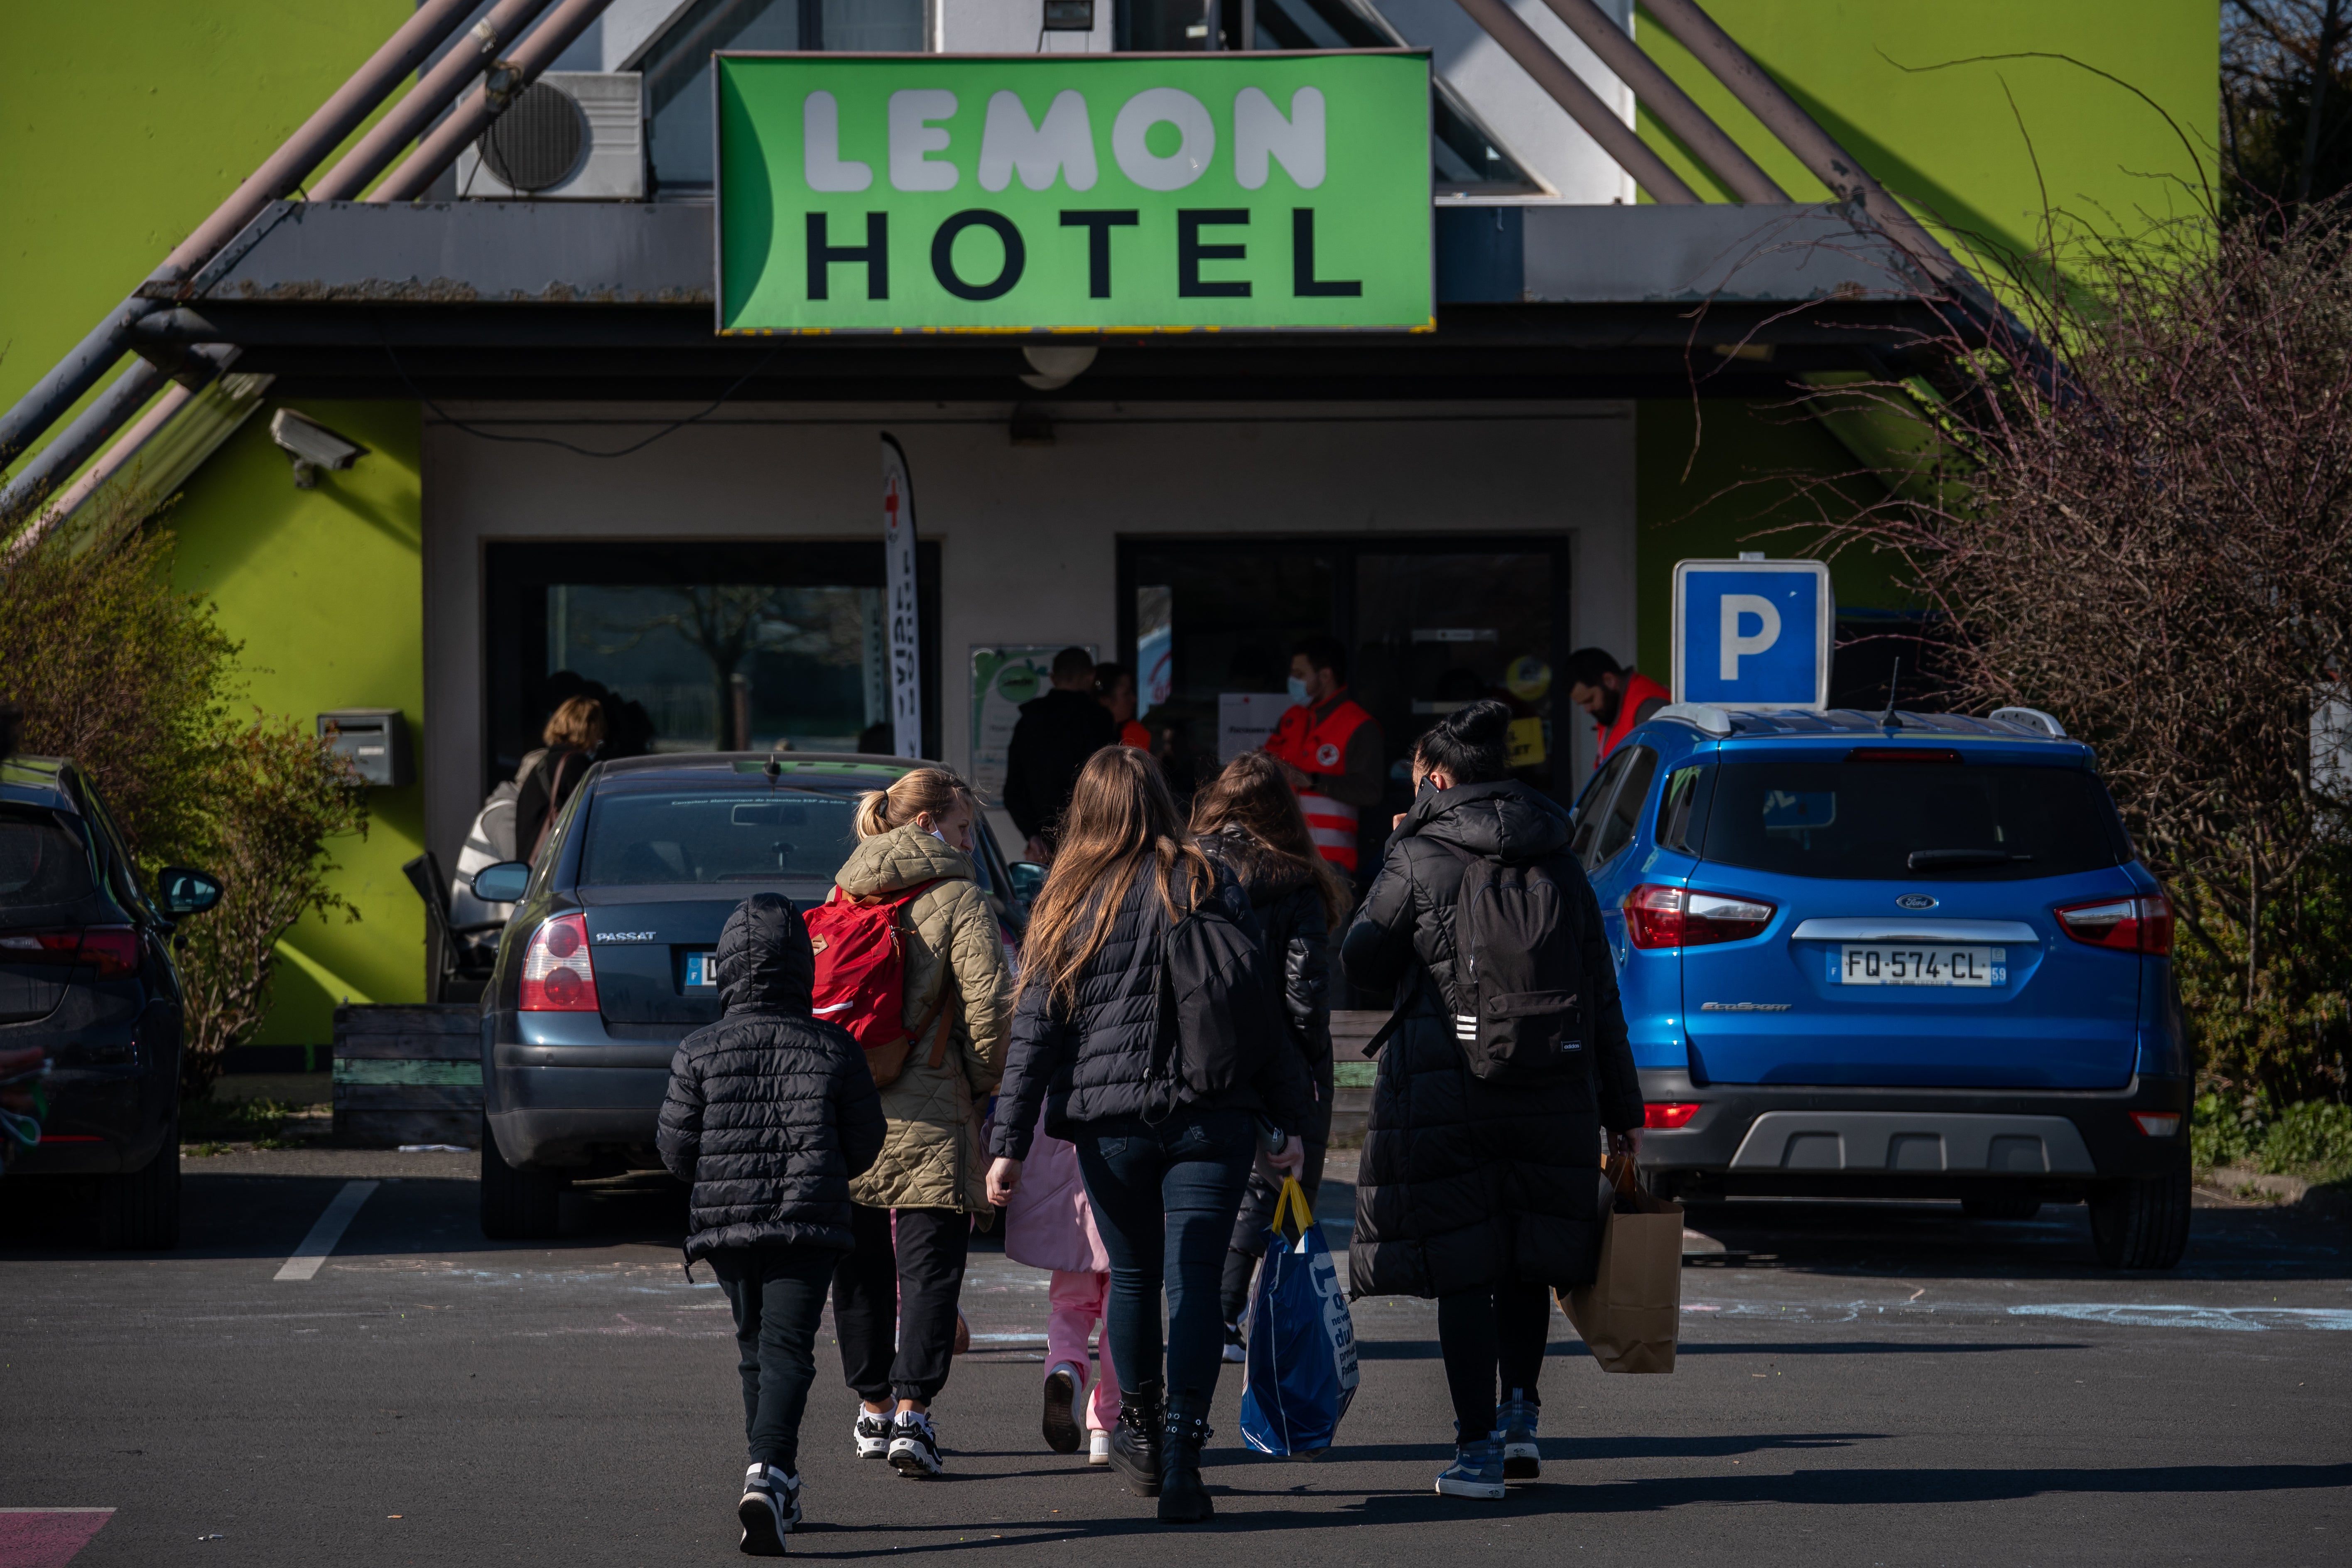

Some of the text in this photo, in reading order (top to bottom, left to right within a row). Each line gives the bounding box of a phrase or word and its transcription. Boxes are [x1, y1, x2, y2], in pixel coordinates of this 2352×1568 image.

[804, 85, 1327, 193] LEMON
[805, 207, 1363, 302] HOTEL
[1720, 594, 1781, 680] P
[1906, 896, 1928, 907] Ford
[596, 932, 657, 942] PASSAT
[1831, 967, 1837, 977] F
[1849, 950, 1983, 979] FQ-574-CL
[691, 972, 698, 981] F
[1992, 967, 2006, 981] 59
[1335, 1328, 1351, 1348] du
